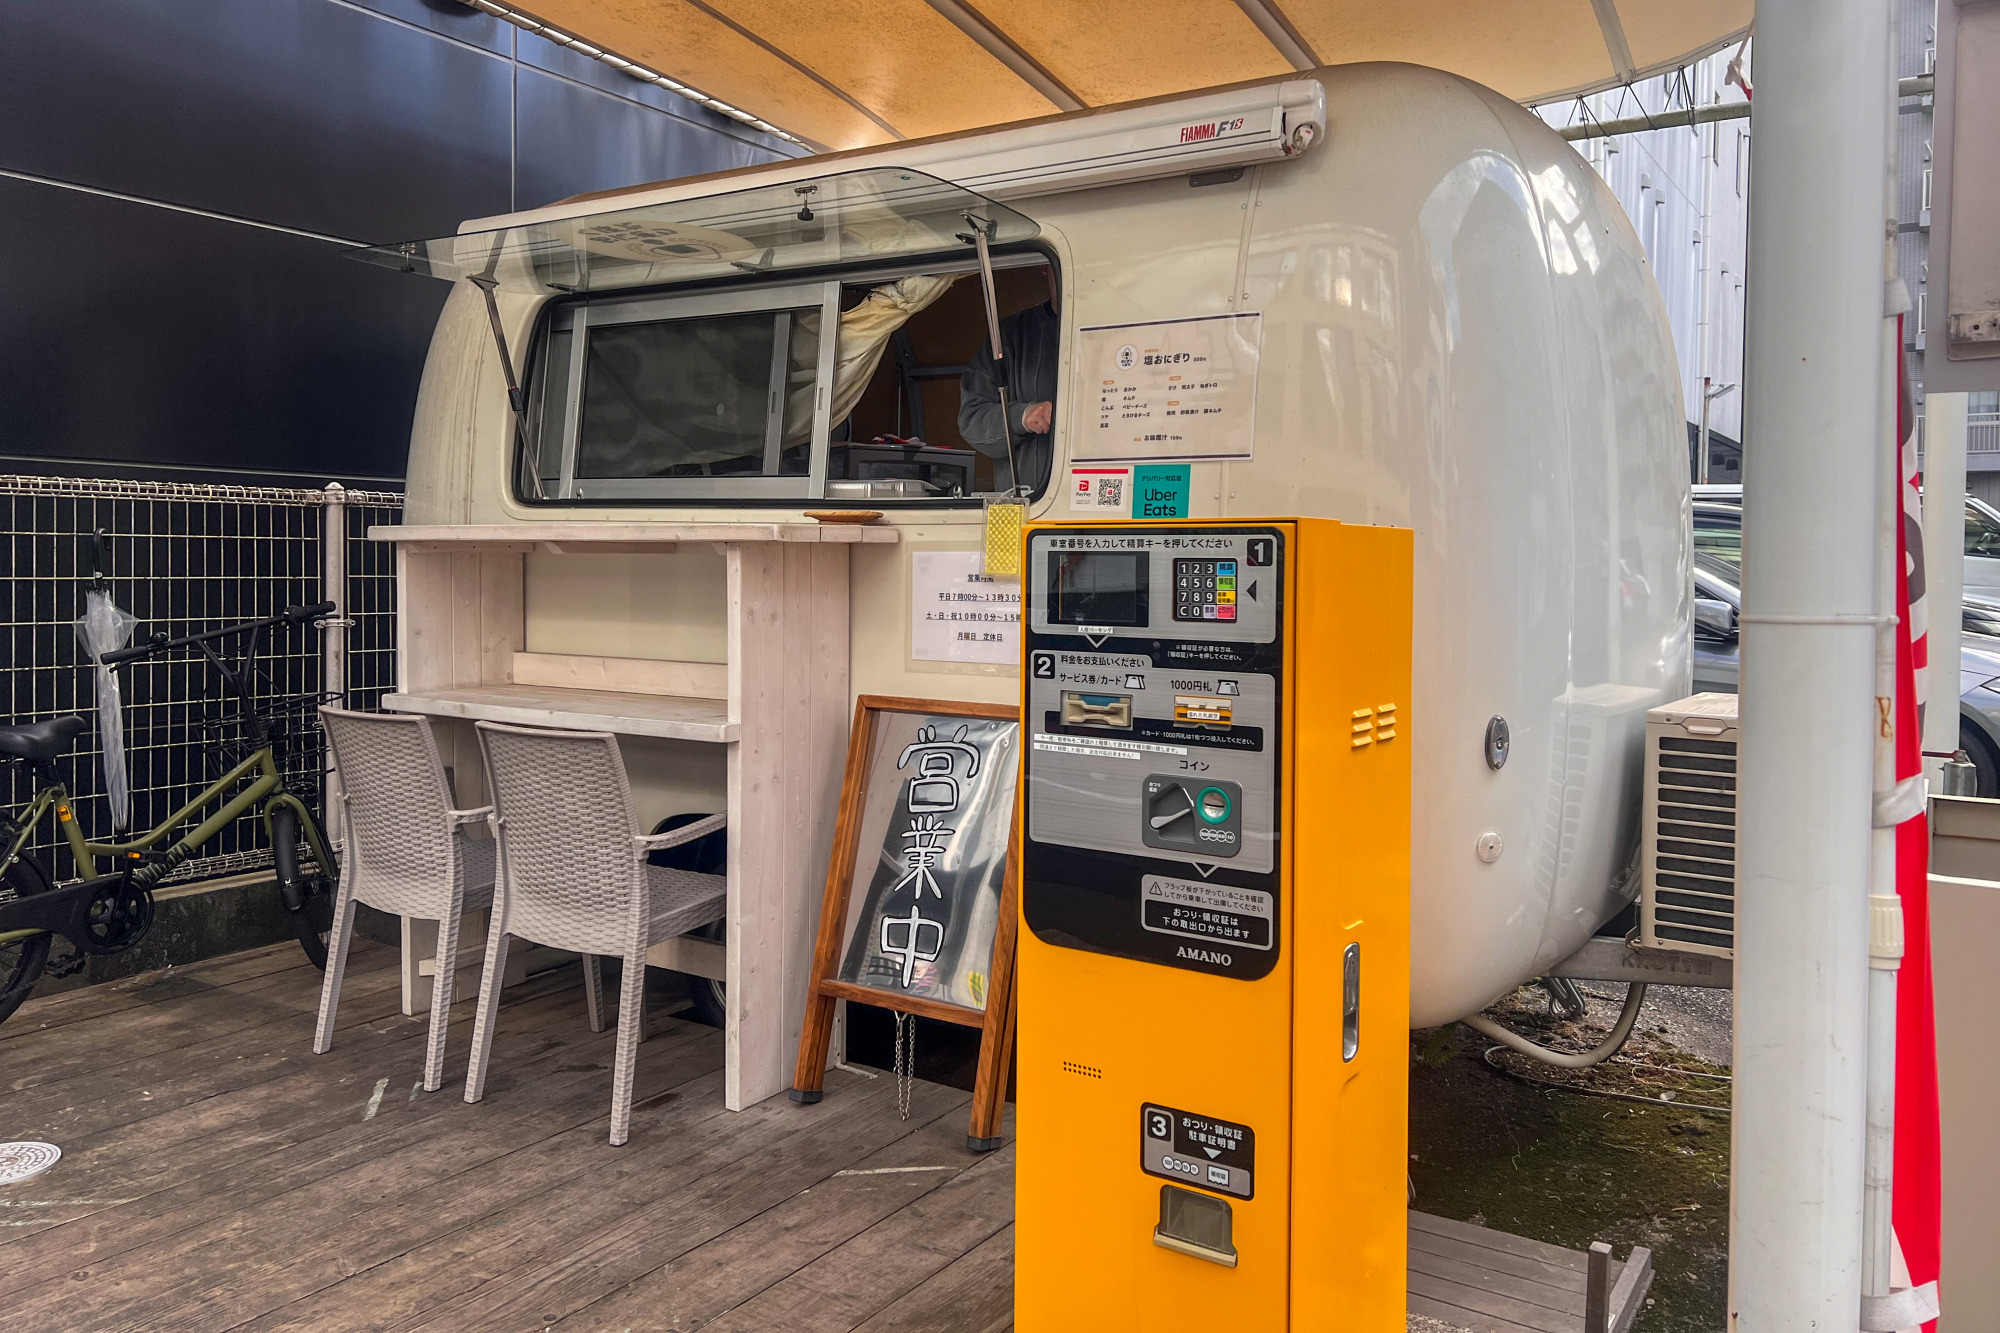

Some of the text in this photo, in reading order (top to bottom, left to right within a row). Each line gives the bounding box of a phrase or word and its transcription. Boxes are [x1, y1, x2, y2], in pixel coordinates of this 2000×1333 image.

[1180, 123, 1216, 143] FIAMMA
[1144, 353, 1190, 365] 塩おにぎり
[1145, 489, 1177, 501] Uber
[1144, 504, 1177, 516] Eats
[1050, 539, 1265, 562] 車室番号を入力して精算キーを押してください 1
[1181, 564, 1186, 573] 1
[1194, 564, 1200, 573] 2
[1207, 564, 1213, 573] 3
[1181, 578, 1187, 587] 4
[1194, 579, 1200, 588] 5
[1207, 579, 1213, 588] 6
[1181, 593, 1187, 601] 7
[1194, 593, 1200, 602] 8
[1207, 593, 1213, 602] 9
[1180, 607, 1187, 616] C
[1194, 607, 1200, 616] 0
[957, 632, 1003, 642] 月曜日 定休日
[1038, 655, 1145, 676] 2 料金をお支払いください
[1060, 674, 1122, 686] サービス券/カード
[1170, 680, 1212, 692] 1000円札
[1180, 760, 1210, 771] コイン
[881, 725, 981, 989] 営業中
[1165, 883, 1264, 904] フラップ板が下がっていることを確認
[1164, 892, 1264, 913] してから乗車して出庫してください
[1173, 908, 1239, 926] おつり・領収証は
[1163, 916, 1250, 939] 下の取出口から出ます
[1177, 947, 1232, 966] AMANO
[1152, 1116, 1243, 1141] 3 おつり・領収証
[1189, 1131, 1236, 1151] 駐車証明書
